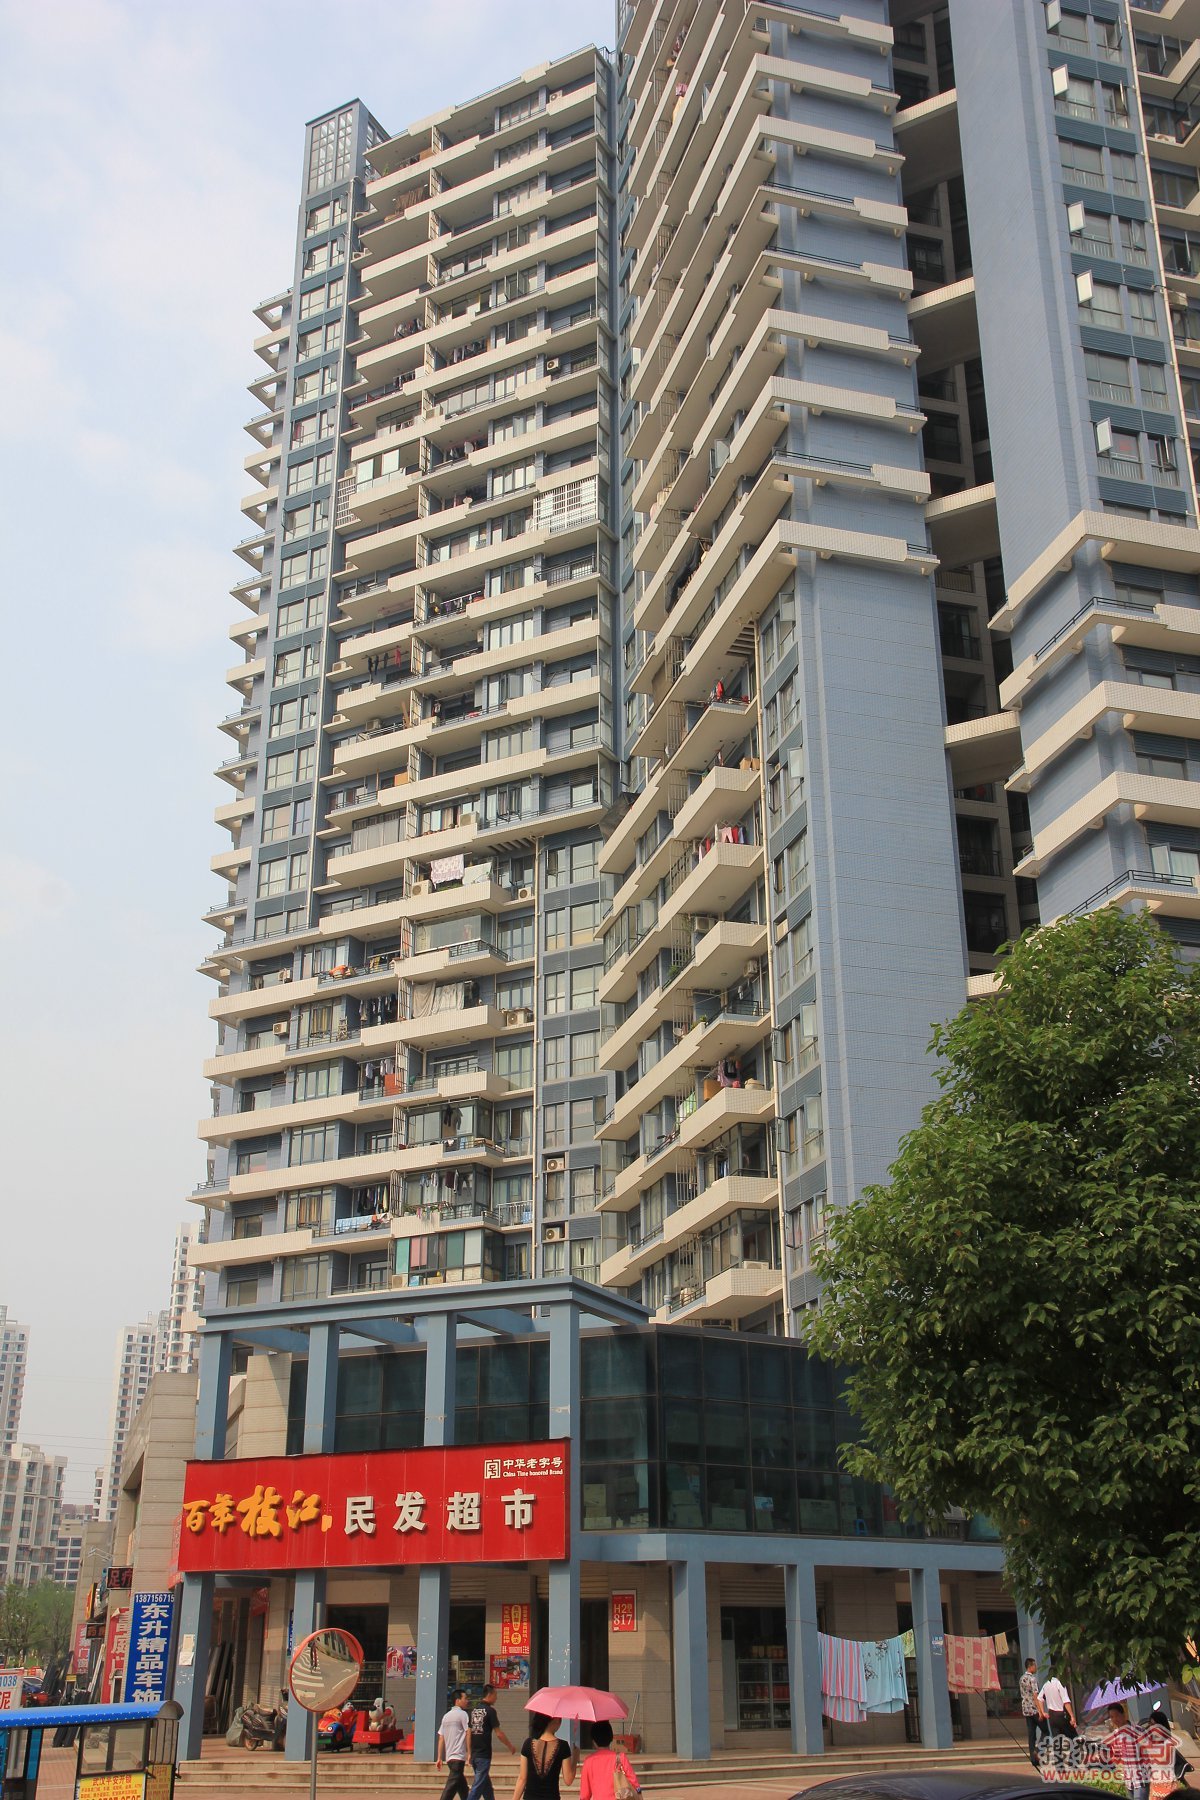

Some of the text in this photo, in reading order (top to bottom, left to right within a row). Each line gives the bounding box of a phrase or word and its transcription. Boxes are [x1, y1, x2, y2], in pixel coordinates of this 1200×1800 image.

[503, 1456, 563, 1470] 中华老字号
[183, 1485, 536, 1537] 百年枝江 民发超市
[108, 1569, 132, 1587] 足疗
[135, 1594, 174, 1602] 1387156715
[613, 1614, 633, 1625] 817
[132, 1603, 170, 1702] 东升精品车饰
